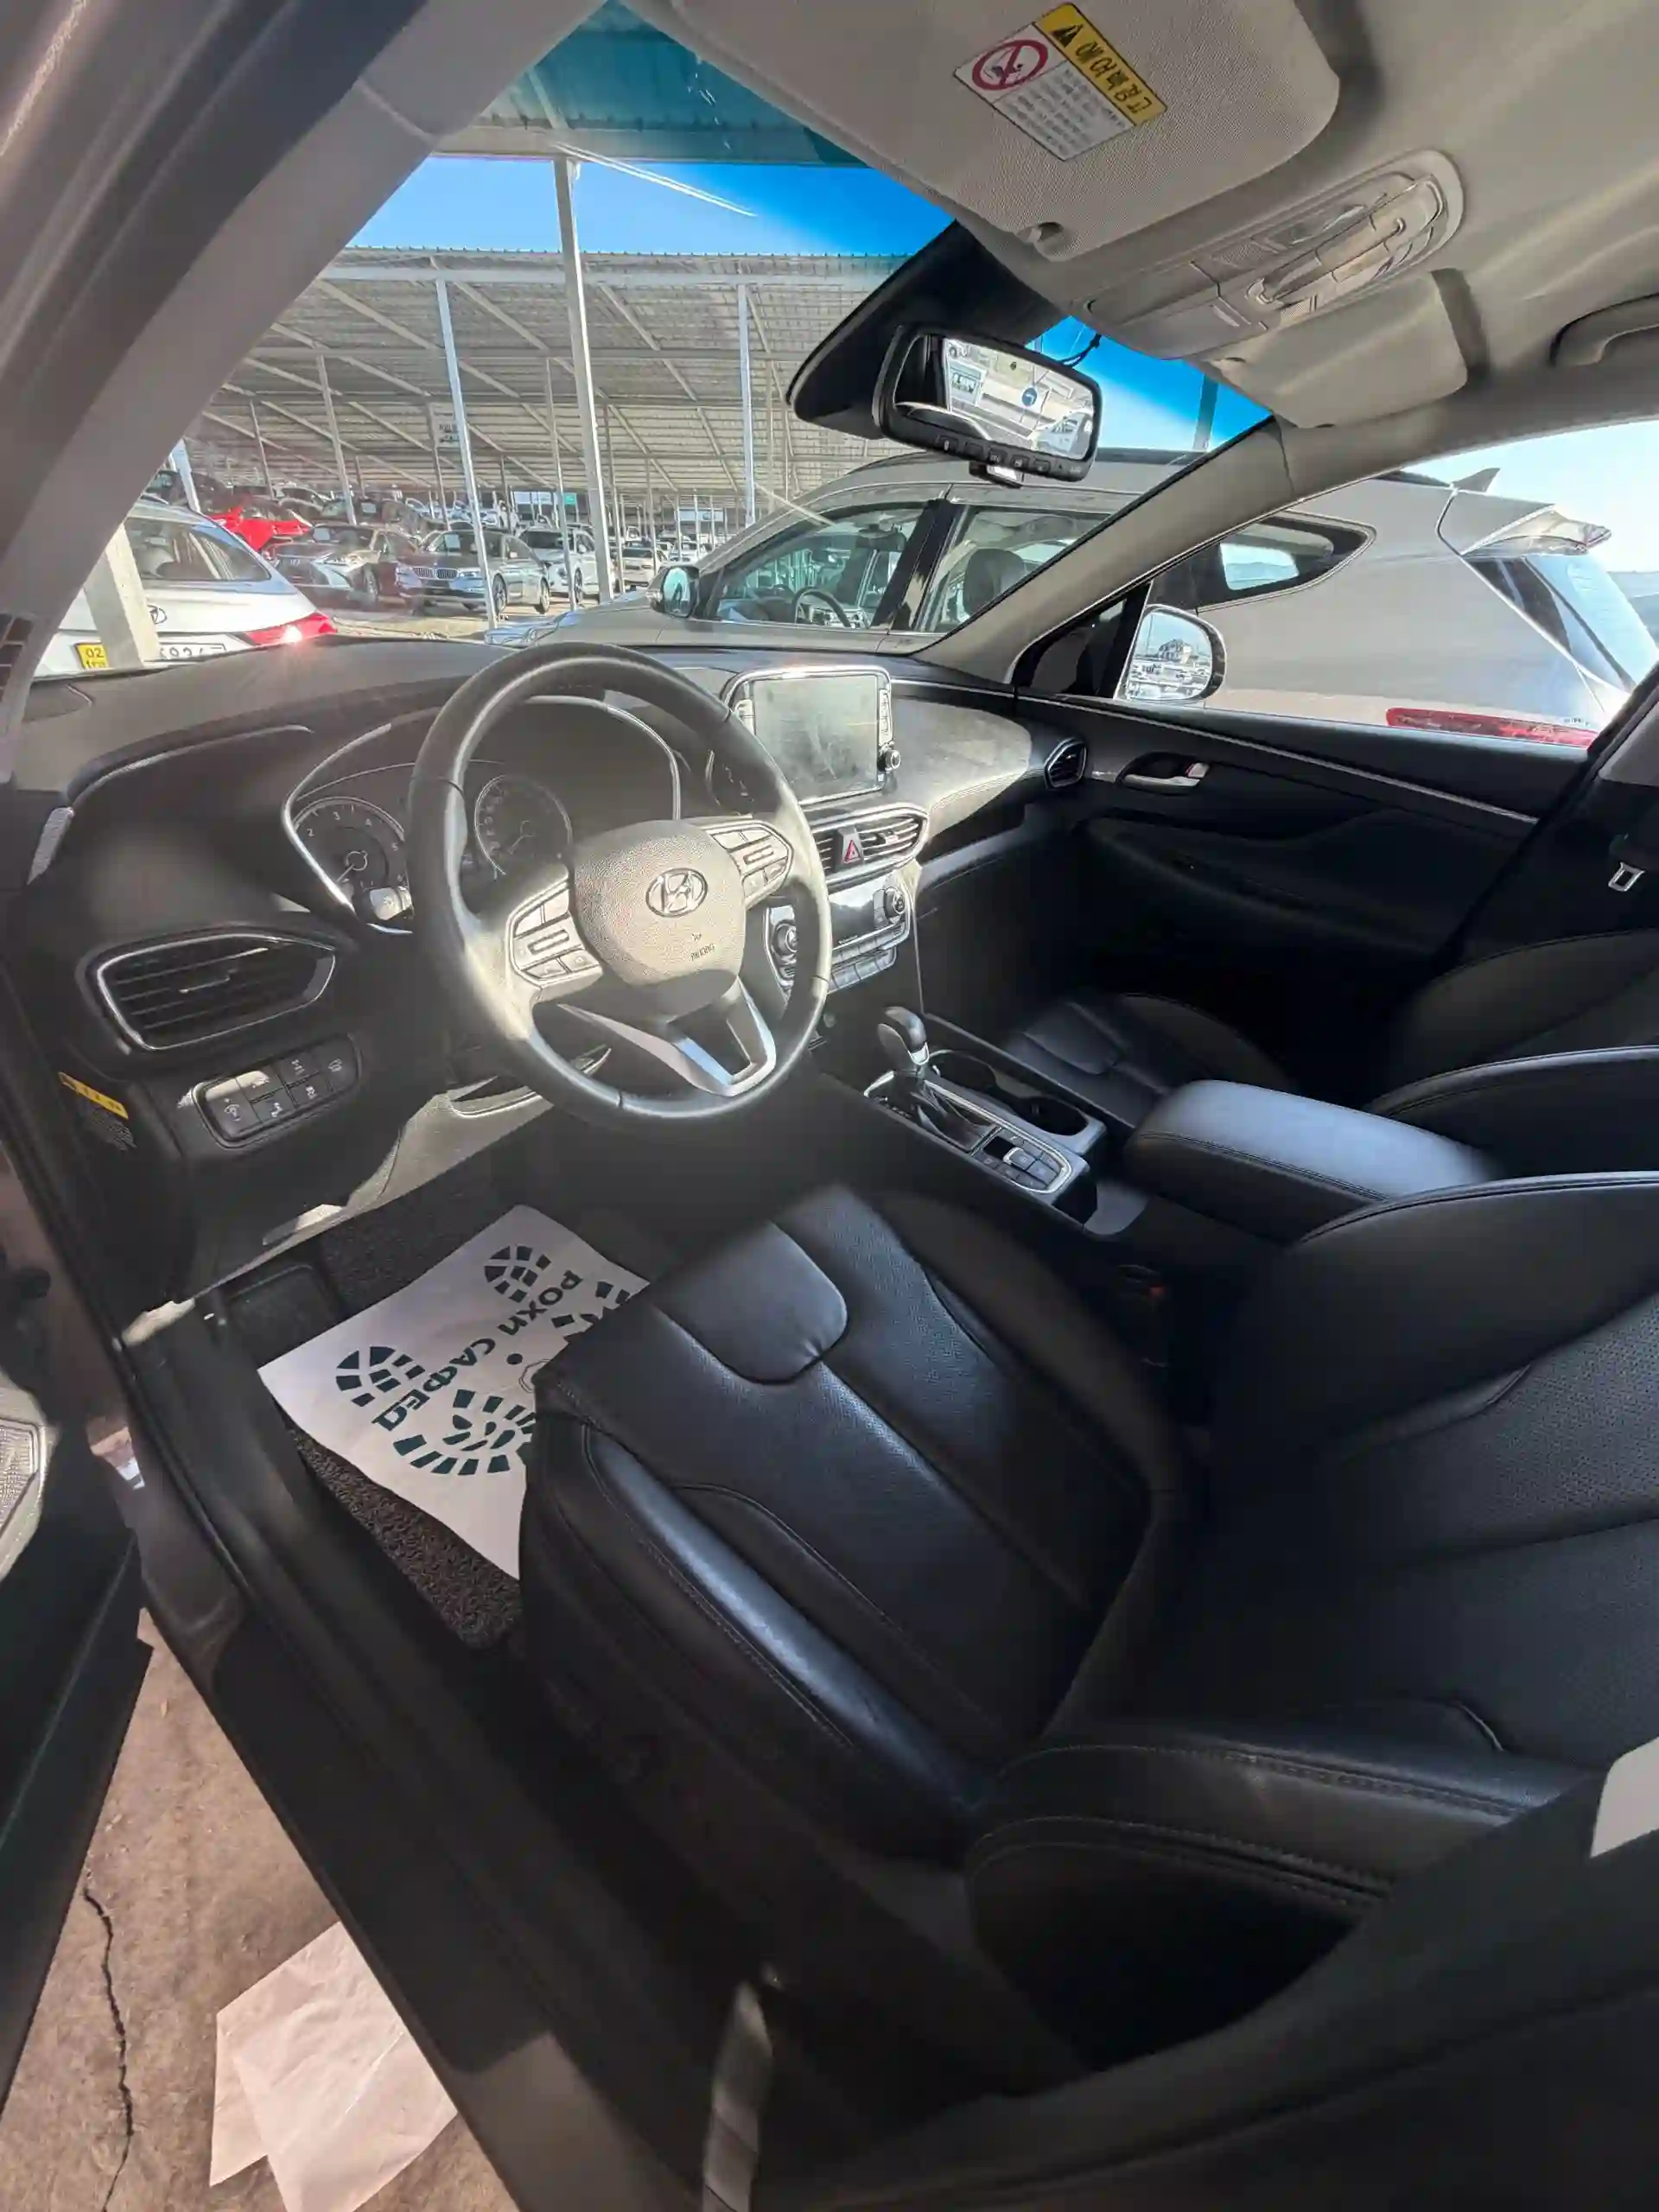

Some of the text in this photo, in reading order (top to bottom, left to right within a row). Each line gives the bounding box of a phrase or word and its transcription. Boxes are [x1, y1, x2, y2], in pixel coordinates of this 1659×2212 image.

[86, 647, 105, 658] 02
[333, 811, 340, 821] 3
[391, 842, 398, 851] 5
